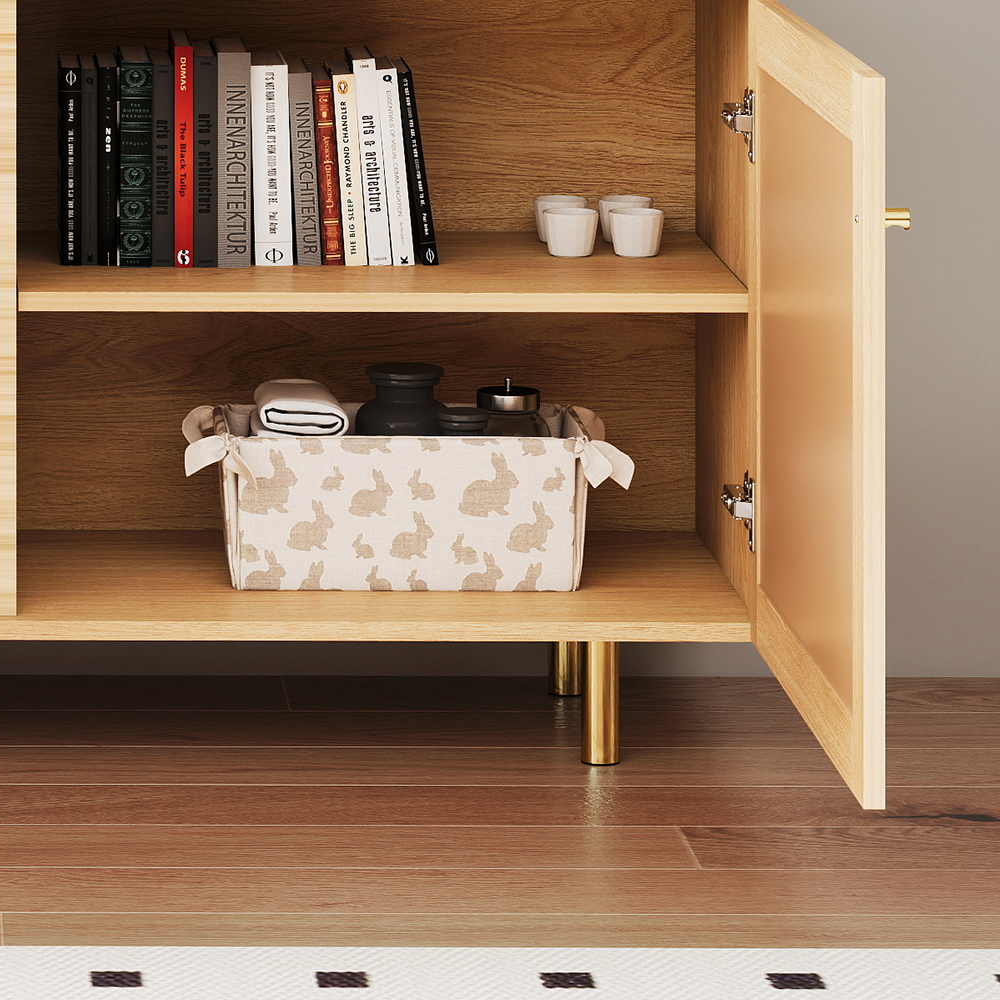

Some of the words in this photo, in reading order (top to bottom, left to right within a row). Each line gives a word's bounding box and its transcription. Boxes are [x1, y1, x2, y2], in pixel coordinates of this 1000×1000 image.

[265, 72, 274, 80] IT'S
[265, 82, 275, 90] NOT
[266, 91, 274, 100] HOW
[386, 90, 394, 128] ESSENTIALS
[198, 114, 213, 133] arts
[266, 115, 275, 123] YOU
[340, 101, 349, 144] CHANDLER
[362, 115, 376, 134] arts
[156, 119, 169, 139] arts
[265, 125, 275, 134] ARE,
[390, 130, 396, 138] OF
[267, 145, 276, 154] HOW
[226, 85, 246, 255] INNENARCHITEKTUR
[343, 146, 353, 188] RAYMOND
[156, 155, 170, 216] architecture
[198, 151, 213, 214] architecture
[268, 178, 277, 189] WANT
[296, 102, 317, 255] INNENARCHITEKTUR
[365, 152, 381, 212] architecture
[392, 162, 403, 217] COMMUNICATION
[269, 212, 278, 221] Paul
[269, 222, 278, 234] Arden
